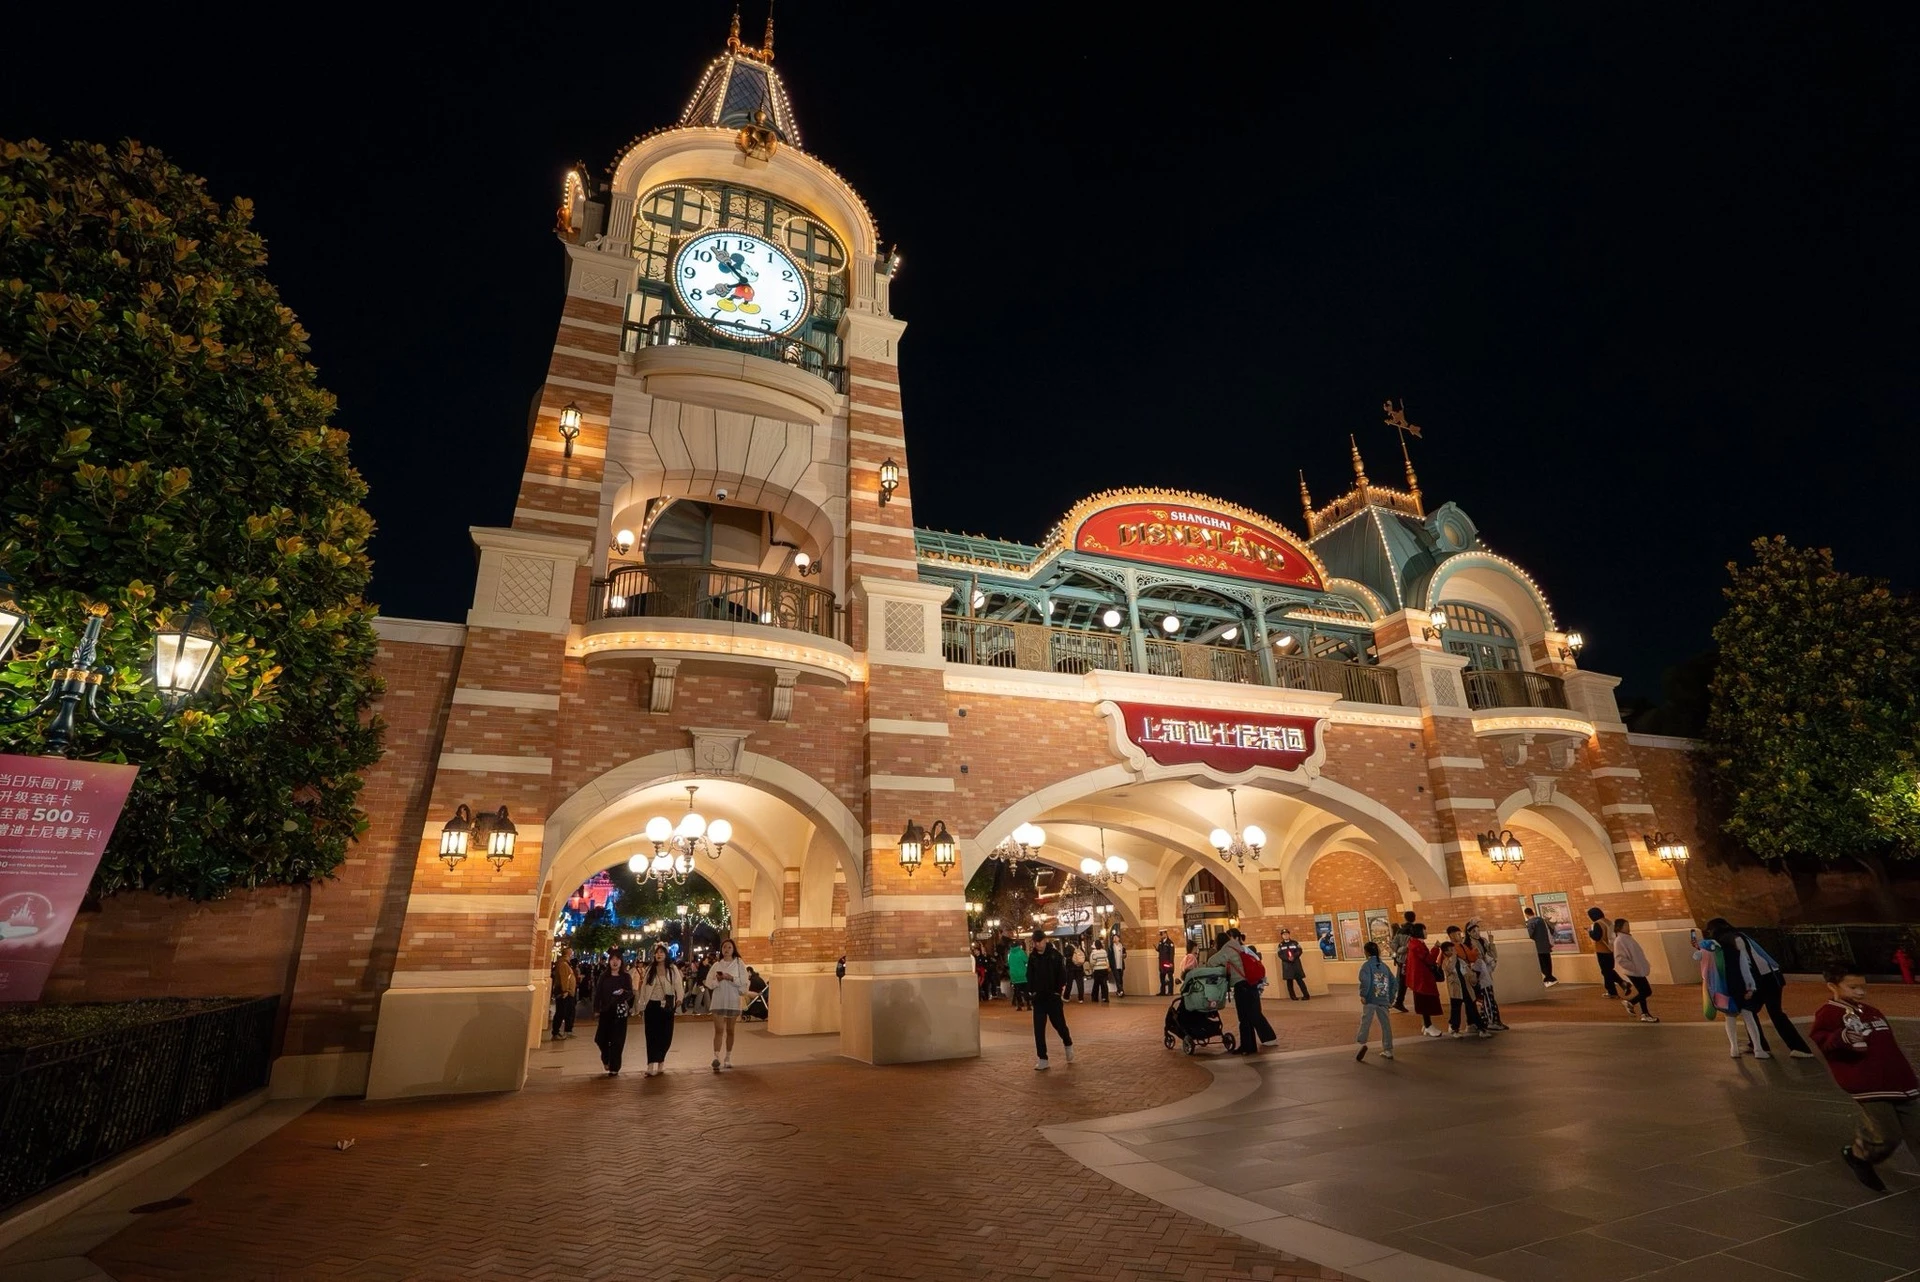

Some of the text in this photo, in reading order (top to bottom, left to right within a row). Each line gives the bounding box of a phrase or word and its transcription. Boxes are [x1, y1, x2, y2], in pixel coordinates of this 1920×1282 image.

[716, 239, 728, 251] 11
[737, 240, 755, 254] 12
[693, 250, 712, 263] 10
[767, 252, 773, 264] 1
[684, 266, 696, 279] 9
[782, 270, 793, 282] 2
[690, 288, 702, 301] 8
[787, 290, 799, 302] 3
[710, 307, 721, 320] 7
[780, 309, 791, 320] 4
[760, 319, 771, 331] 5
[1170, 511, 1231, 531] SHANGHAI
[1118, 522, 1285, 572] DISNEYLAND
[1138, 716, 1307, 752] 上海迪士尼乐园
[0, 773, 84, 791] 当日乐园门票
